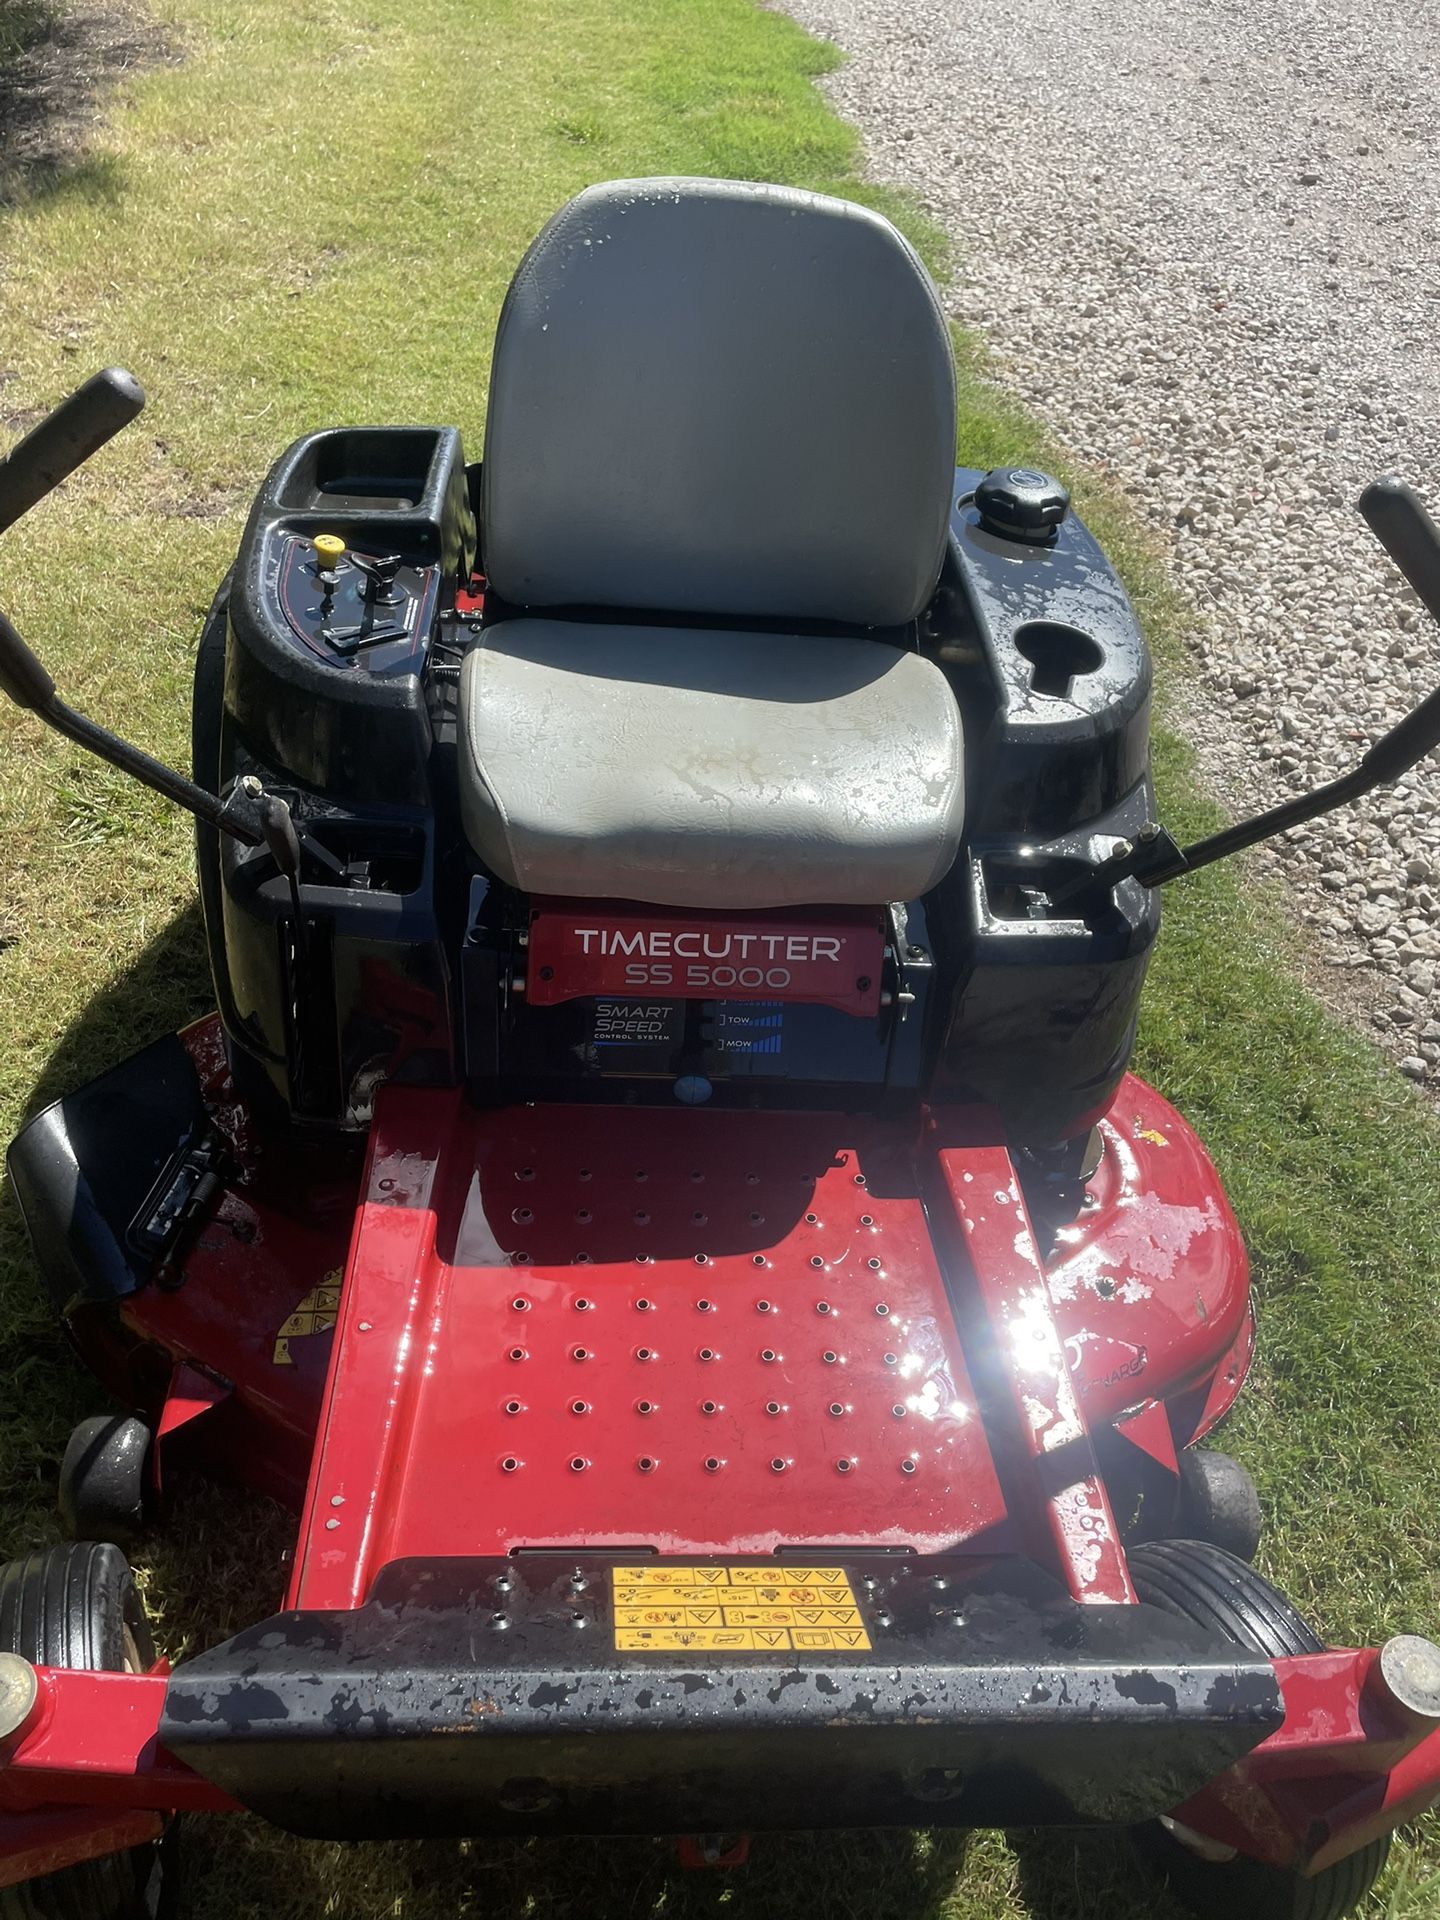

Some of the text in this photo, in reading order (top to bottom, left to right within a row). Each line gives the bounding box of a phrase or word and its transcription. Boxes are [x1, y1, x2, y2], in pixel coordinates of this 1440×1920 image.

[574, 928, 846, 962] TIMECUTTER
[624, 963, 791, 989] SS 5000
[595, 1004, 673, 1019] SMART
[594, 1018, 664, 1033] SPEED
[727, 1016, 750, 1024] TOW
[726, 1040, 752, 1048] MOW
